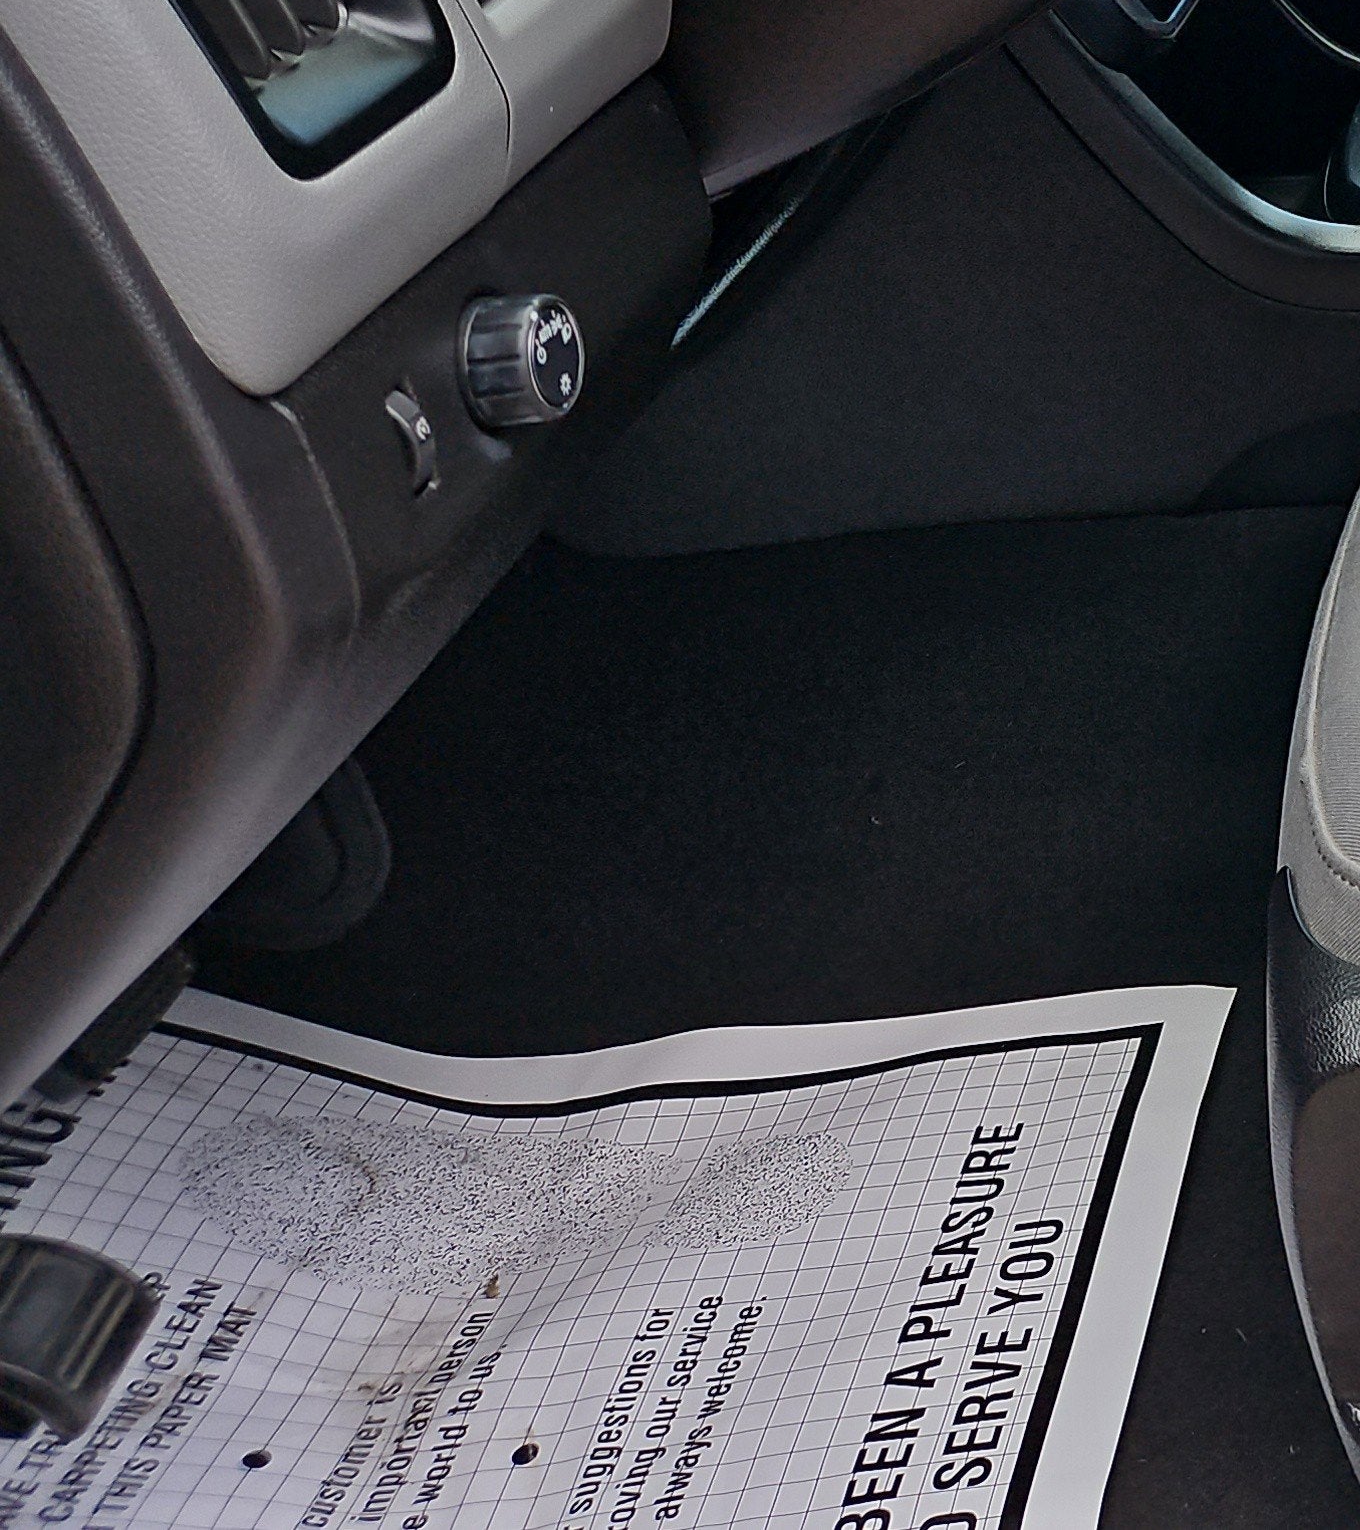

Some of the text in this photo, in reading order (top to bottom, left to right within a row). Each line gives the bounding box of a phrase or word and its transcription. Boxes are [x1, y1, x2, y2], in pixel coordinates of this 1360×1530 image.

[38, 1278, 223, 1522] CARPETING CLEAN
[92, 1457, 160, 1516] THIS
[139, 1371, 221, 1450] PAPER
[198, 1301, 258, 1363] MAT
[350, 1311, 494, 1523] important person
[569, 1308, 675, 1515] suggestions for
[645, 1396, 682, 1439] our
[667, 1295, 724, 1388] service
[653, 1295, 768, 1521] always welcome.
[833, 1121, 1025, 1530] BEEN A PLEASURE
[932, 1326, 1033, 1490] SERVE
[988, 1218, 1065, 1315] YOU
[301, 1382, 403, 1528] customer is
[412, 1424, 469, 1505] world
[447, 1388, 483, 1416] to
